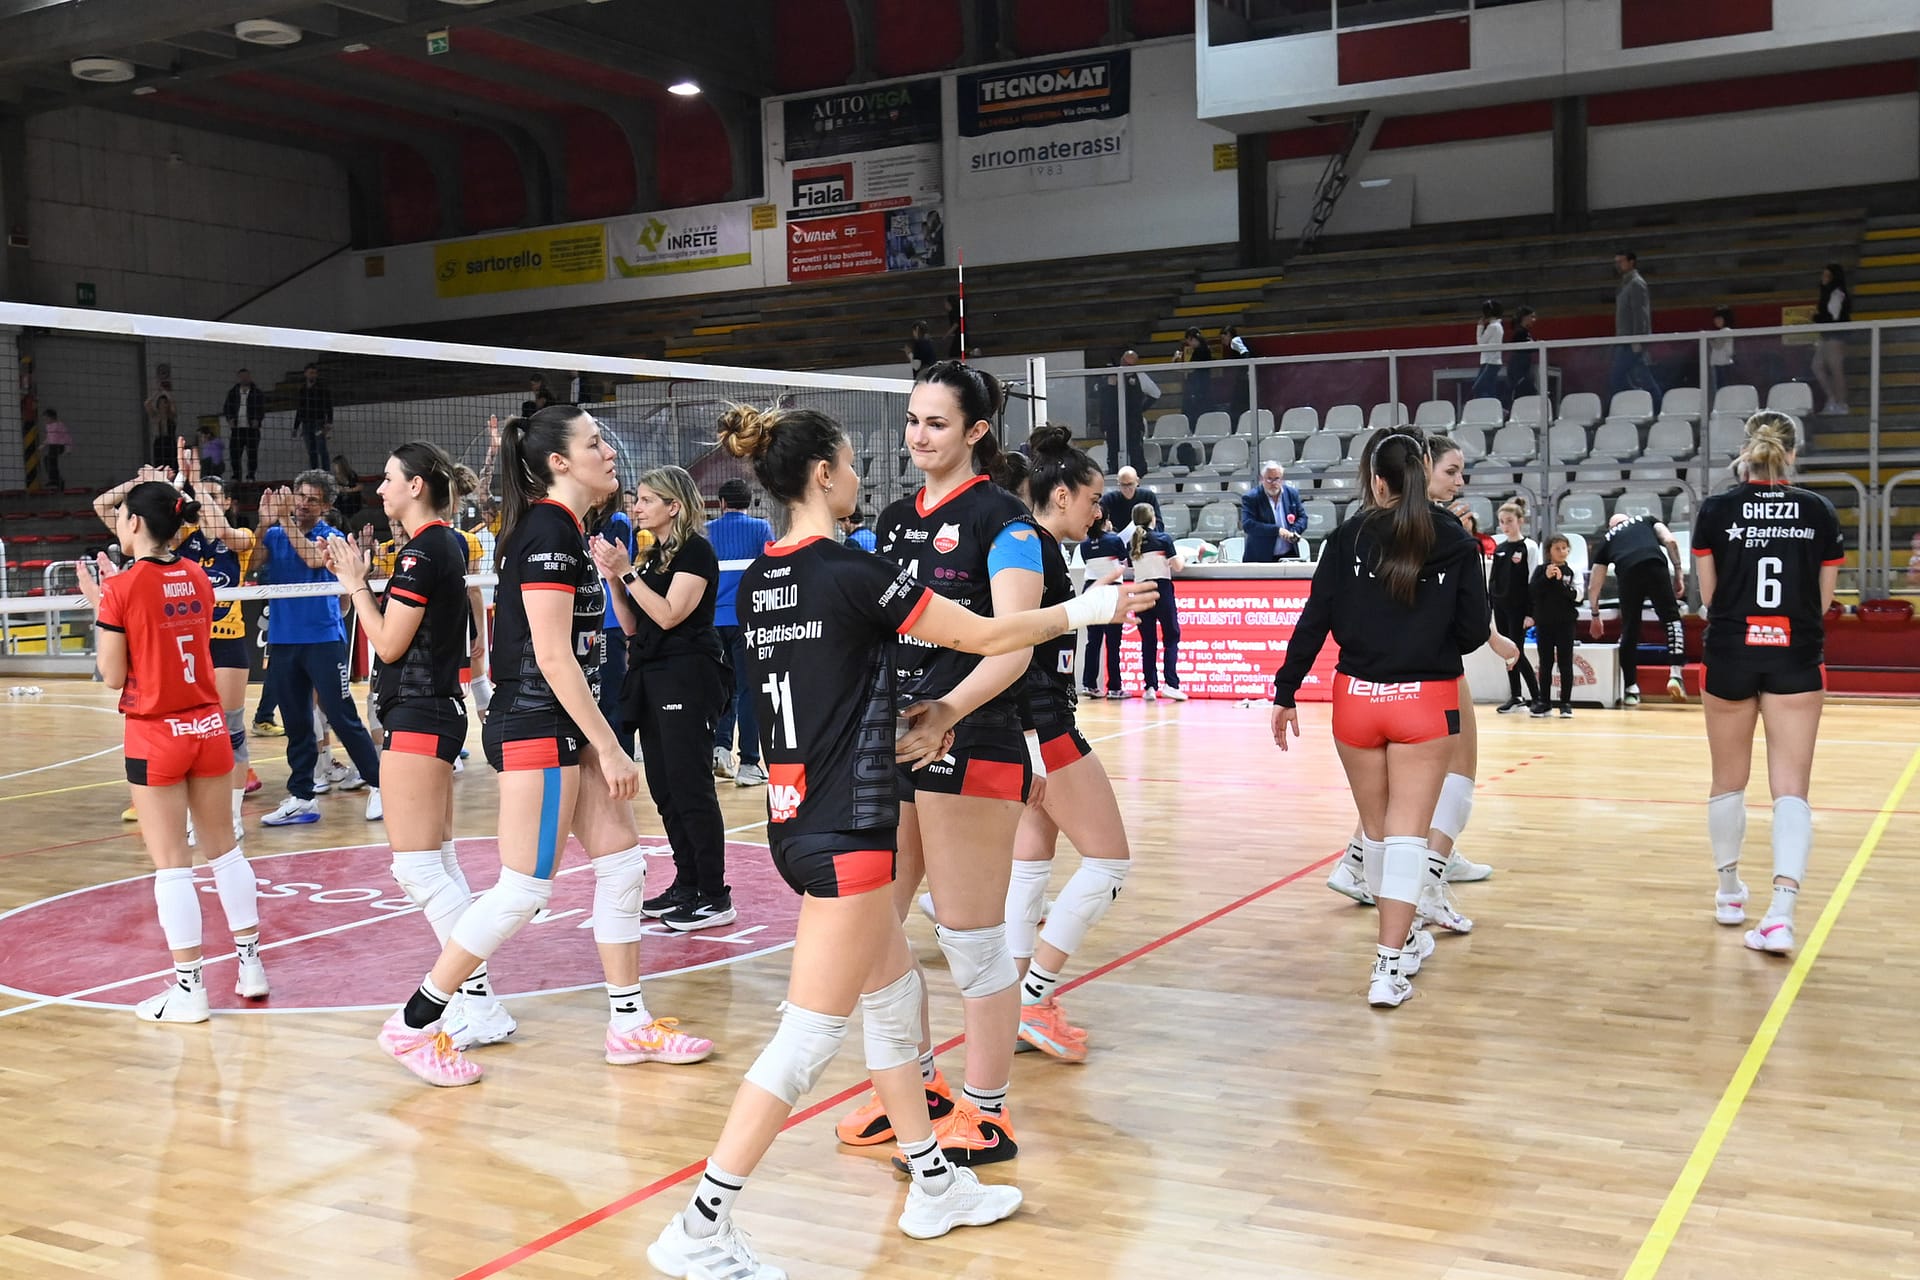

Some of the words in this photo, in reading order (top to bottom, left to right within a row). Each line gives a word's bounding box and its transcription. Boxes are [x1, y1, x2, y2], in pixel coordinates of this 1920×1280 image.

[982, 66, 1105, 101] TECNOMAT
[971, 136, 1120, 170] siriomaterassi
[1029, 164, 1064, 176] 1983
[793, 177, 844, 207] Fiala
[466, 250, 542, 275] sartorello
[828, 253, 842, 261] tuo
[1742, 502, 1799, 520] GHEZZI
[1746, 526, 1816, 540] Battistolli
[1744, 538, 1769, 548] BTV
[544, 562, 559, 571] SERIE
[163, 581, 196, 598] MORRA
[1756, 556, 1783, 608] 6
[752, 583, 798, 613] SPINELLO
[1199, 598, 1216, 608] LA
[1218, 598, 1270, 608] NOSTRA
[1176, 612, 1242, 625] OTRESTI
[757, 621, 823, 645] Battistolli
[176, 634, 196, 684] 5
[758, 645, 774, 660] BTV
[1370, 693, 1420, 703] MEDICAL
[164, 713, 223, 737] Telea
[928, 764, 954, 775] nine
